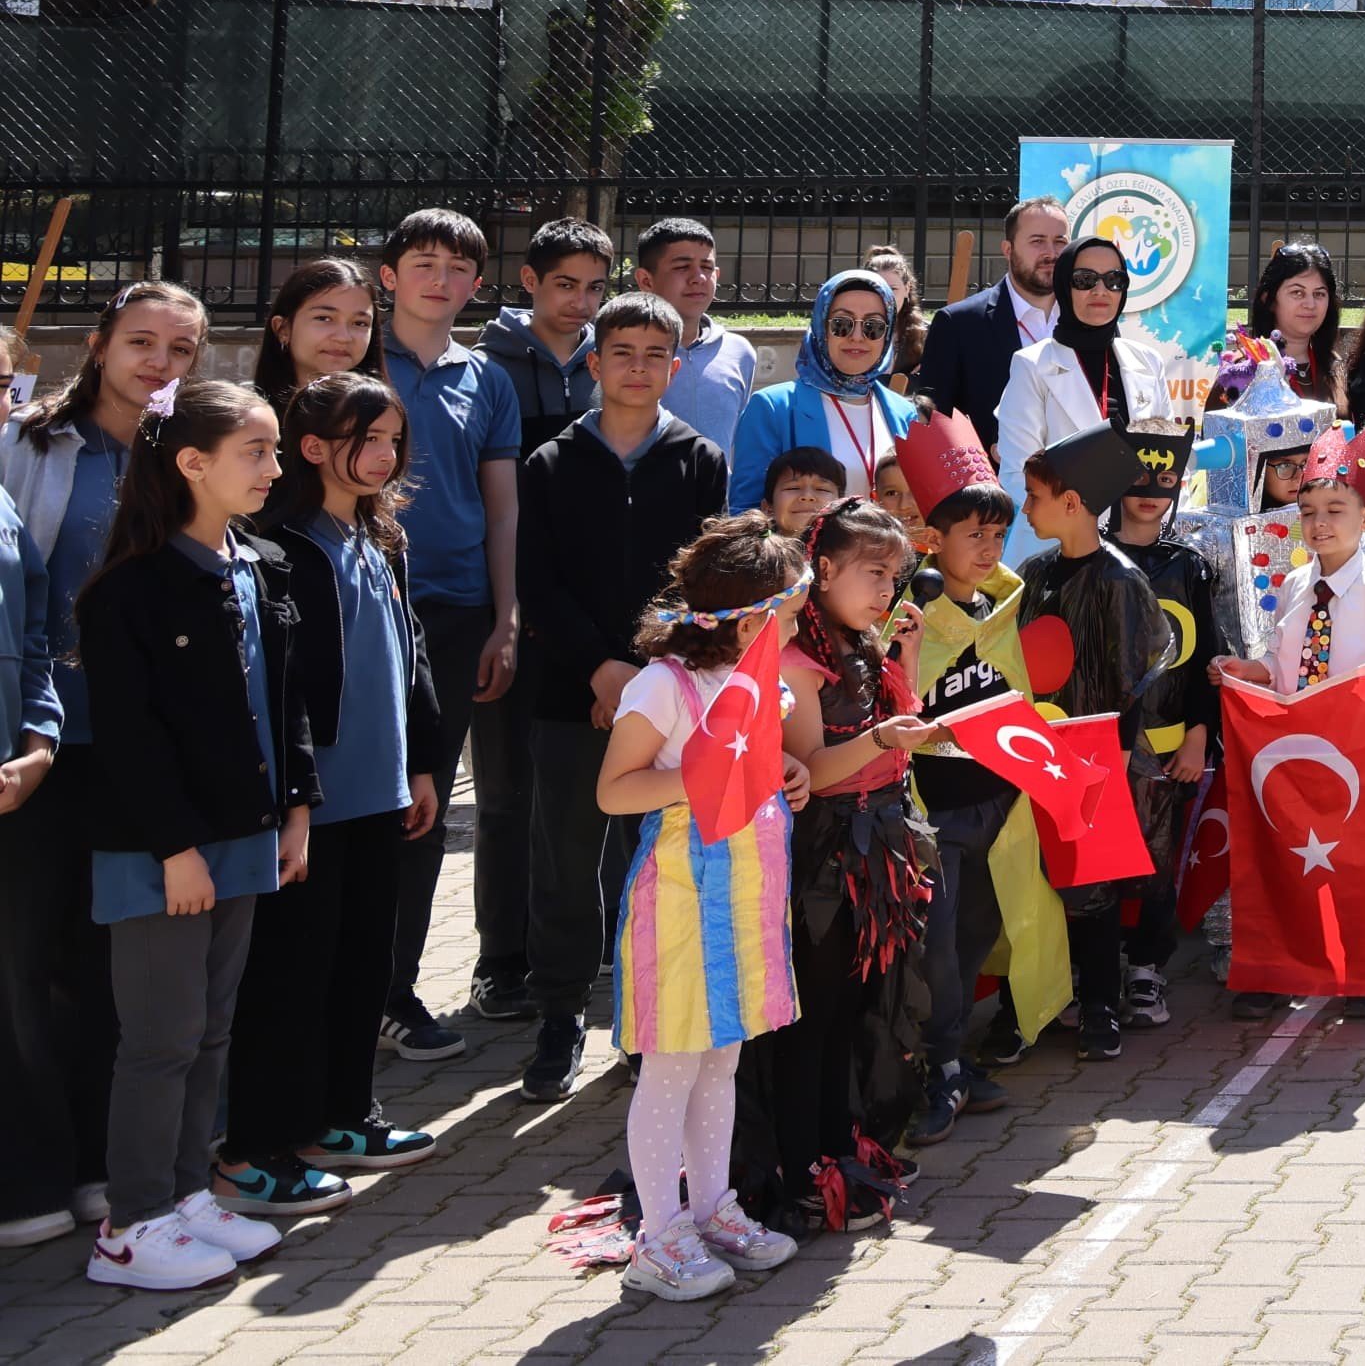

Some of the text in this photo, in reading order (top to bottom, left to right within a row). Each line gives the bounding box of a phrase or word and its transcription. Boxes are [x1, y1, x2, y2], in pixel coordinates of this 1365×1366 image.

[1106, 179, 1129, 189] ÖZEL
[1164, 198, 1191, 247] ANAOKULU
[1168, 379, 1211, 406] VUŞ
